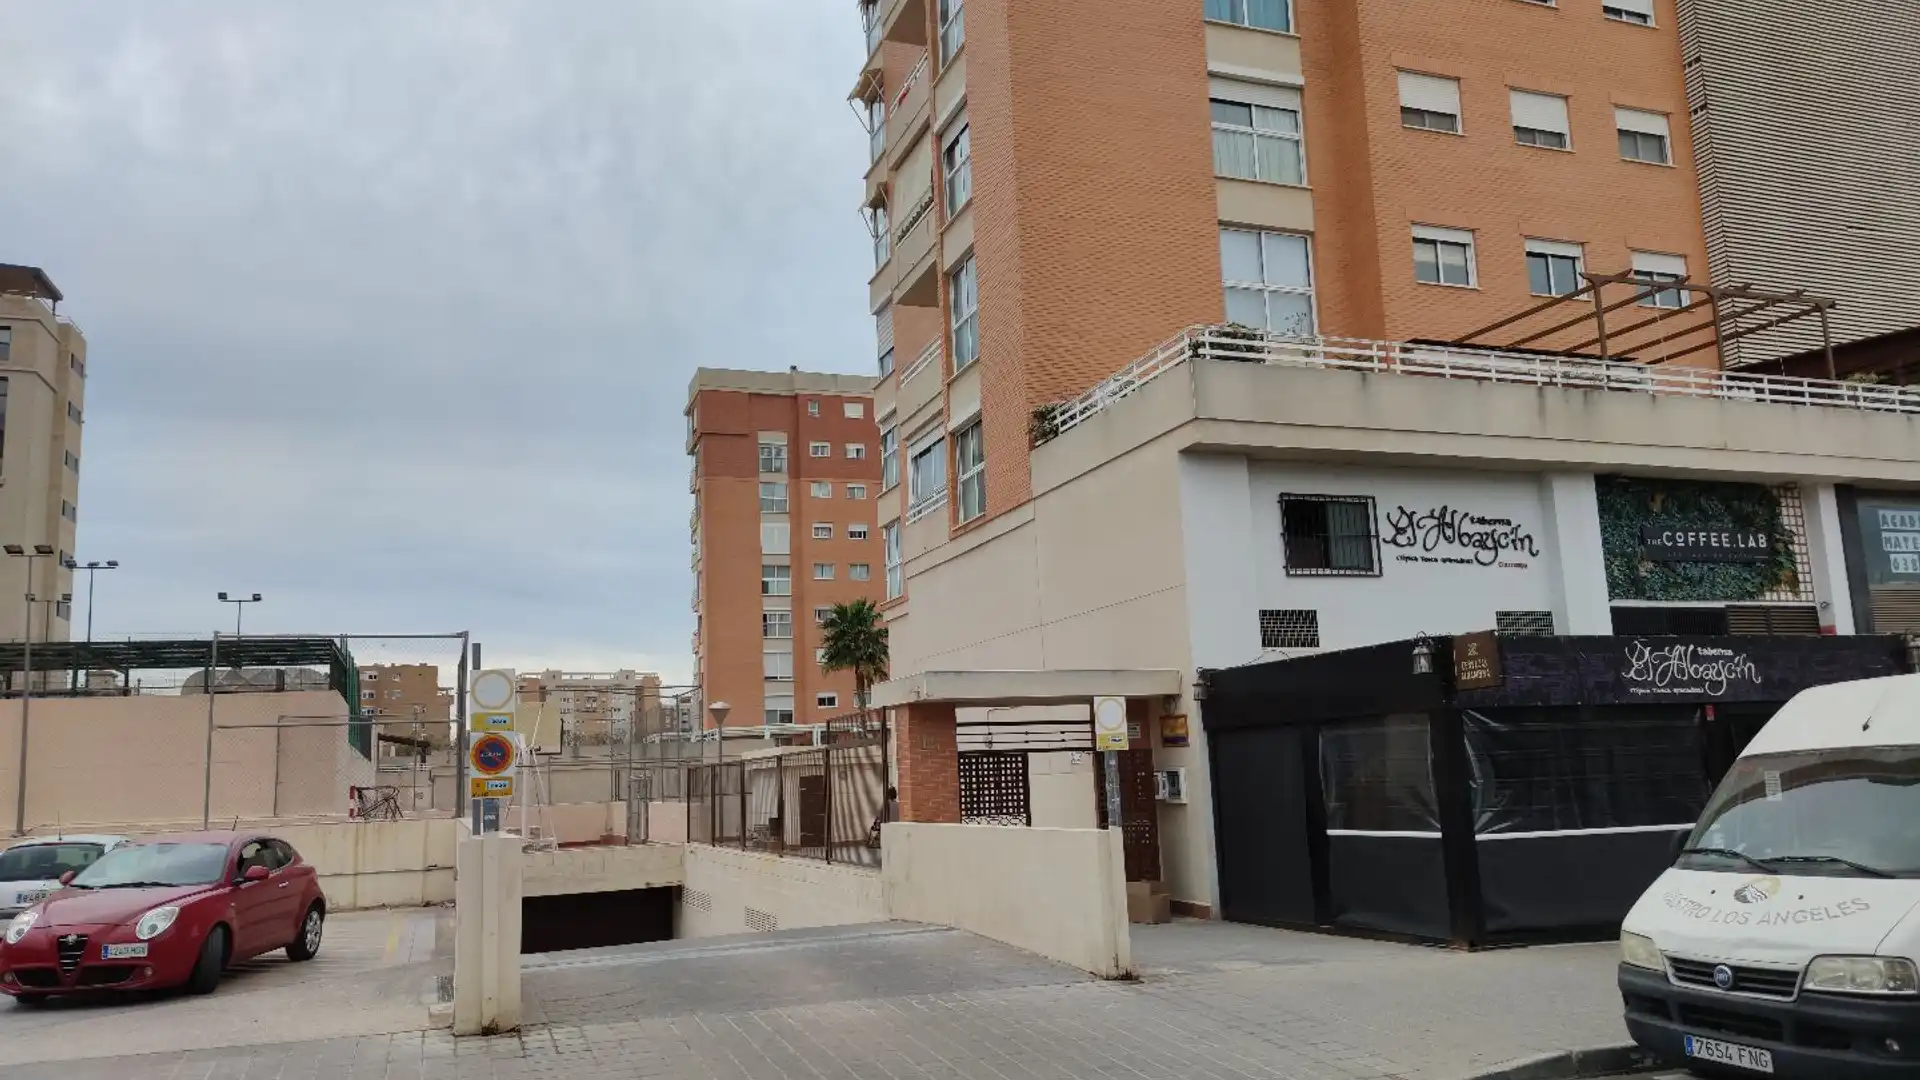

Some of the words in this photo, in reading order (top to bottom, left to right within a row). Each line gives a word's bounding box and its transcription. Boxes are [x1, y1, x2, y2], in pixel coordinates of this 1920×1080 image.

[1709, 911, 1753, 926] LOS
[1756, 897, 1871, 926] ANGELES
[1695, 1038, 1733, 1061] 7654
[1737, 1047, 1769, 1069] FNG
